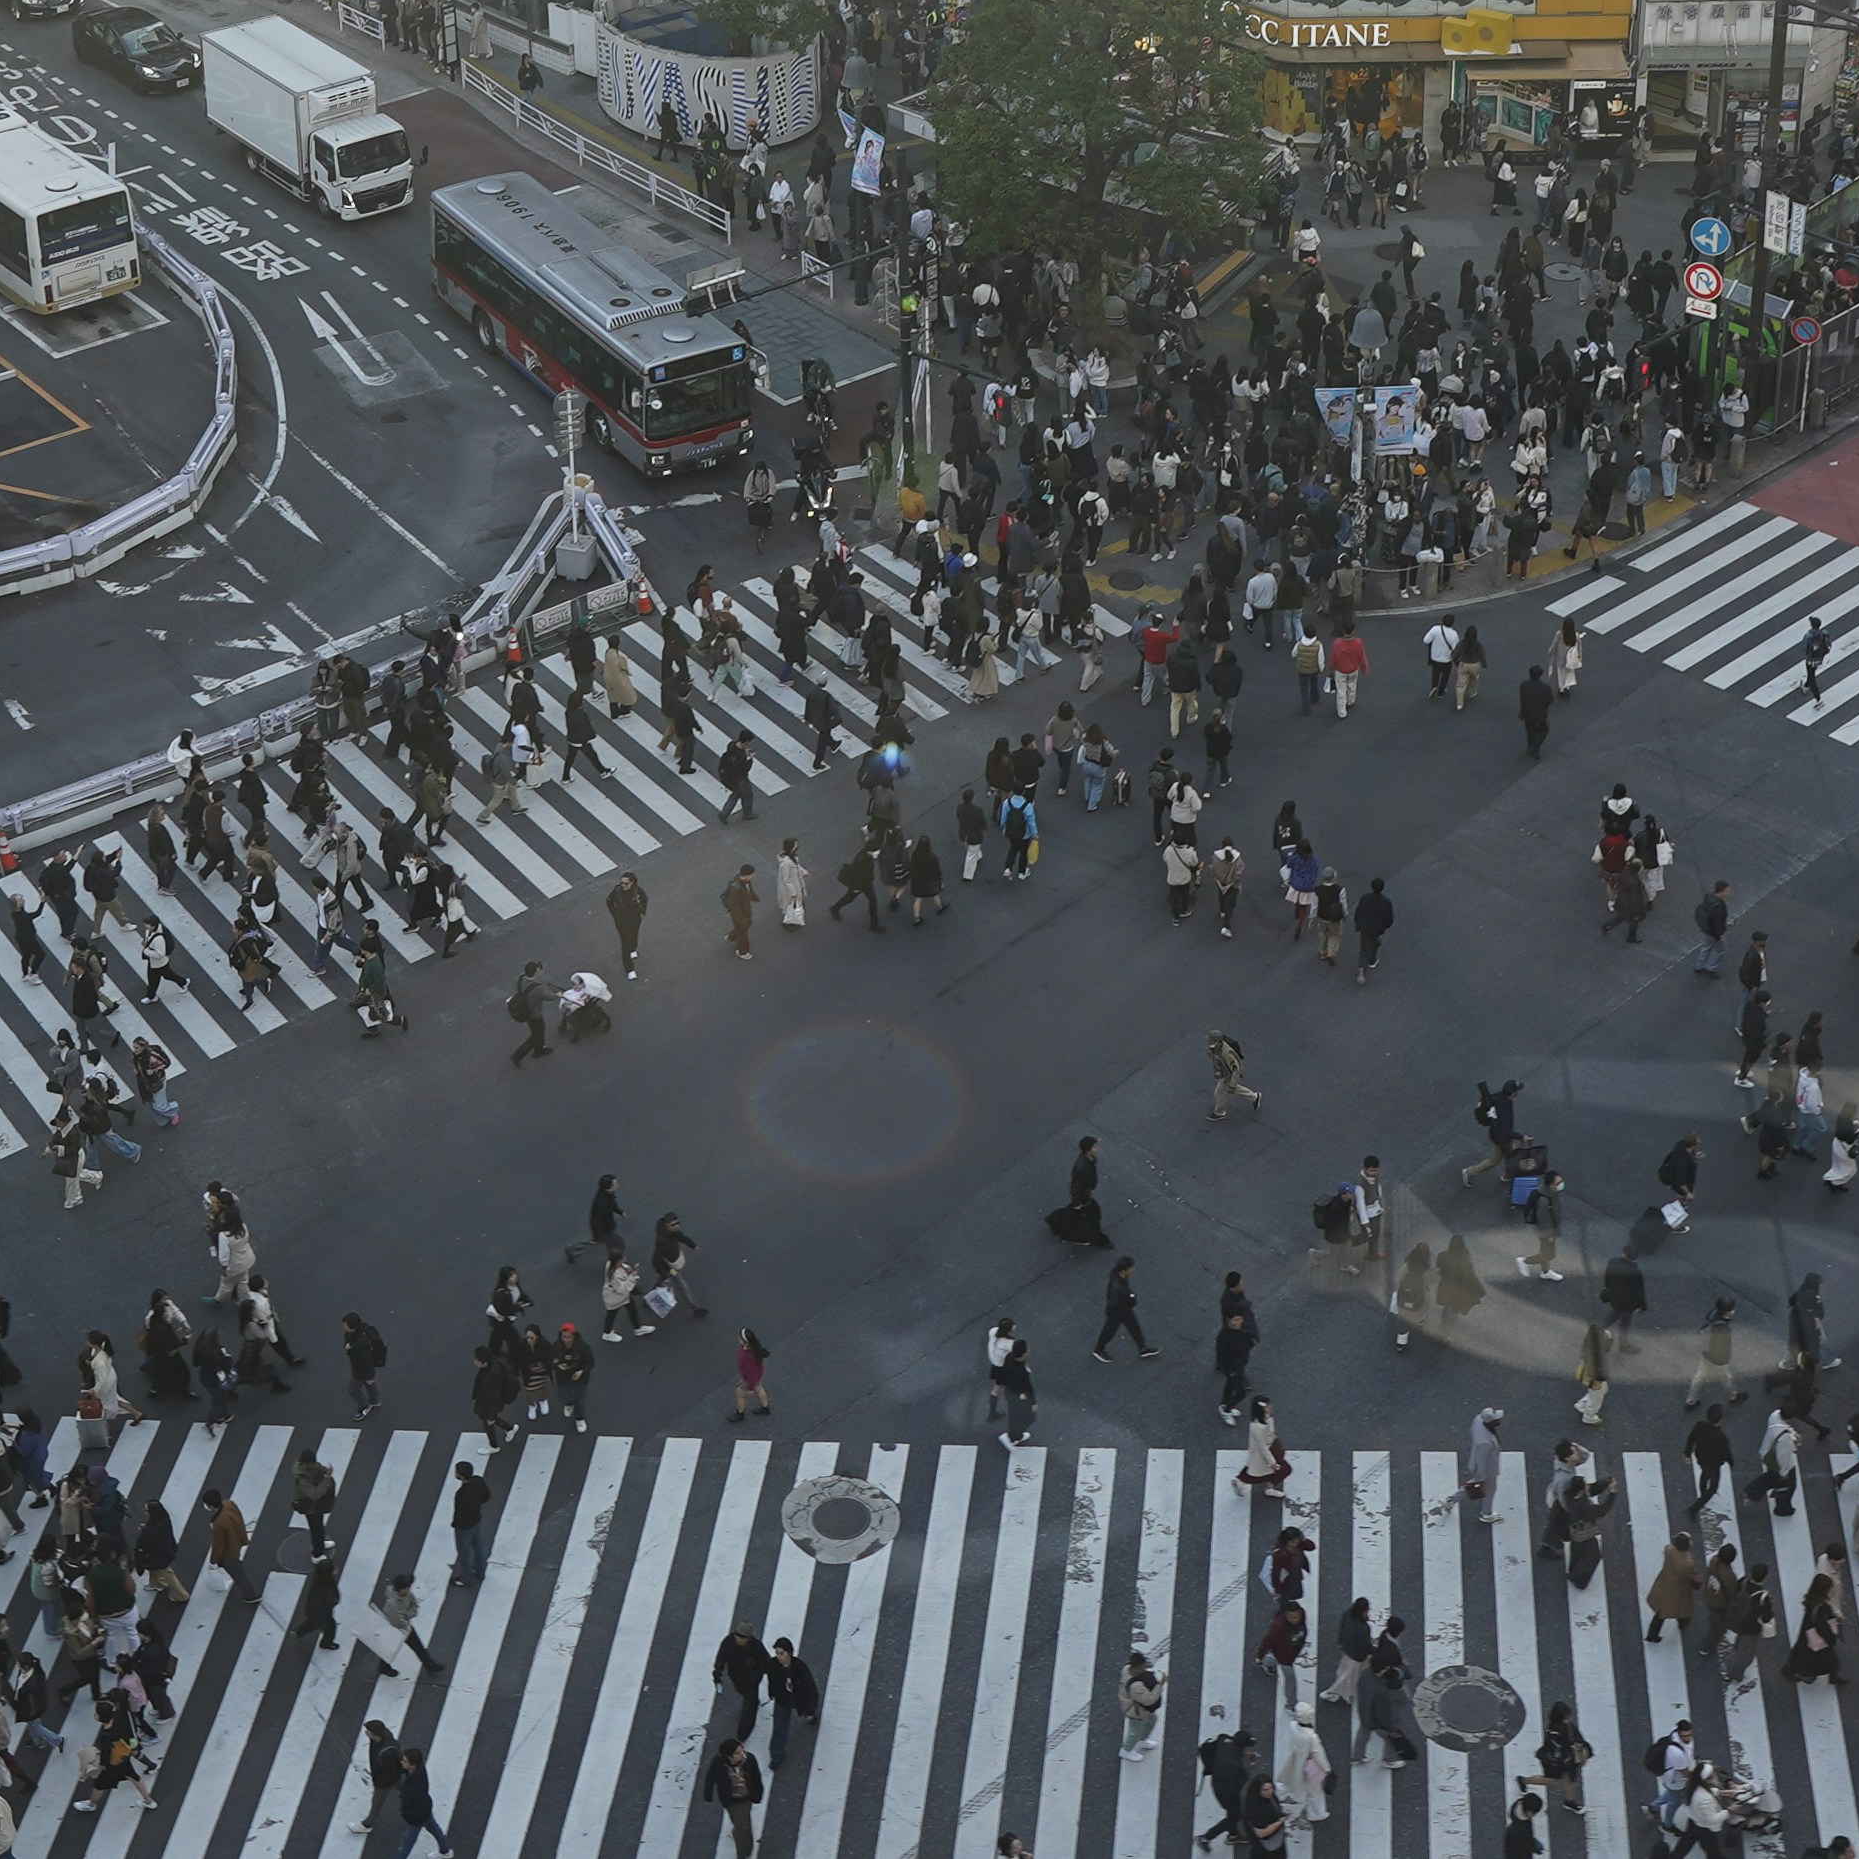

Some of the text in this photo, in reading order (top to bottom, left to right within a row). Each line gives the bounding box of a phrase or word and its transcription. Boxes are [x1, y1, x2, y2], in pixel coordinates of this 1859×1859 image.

[1656, 3, 1803, 21] 渋谷駅前ビル
[496, 192, 536, 221] 1906
[533, 221, 580, 255] 東急バス
